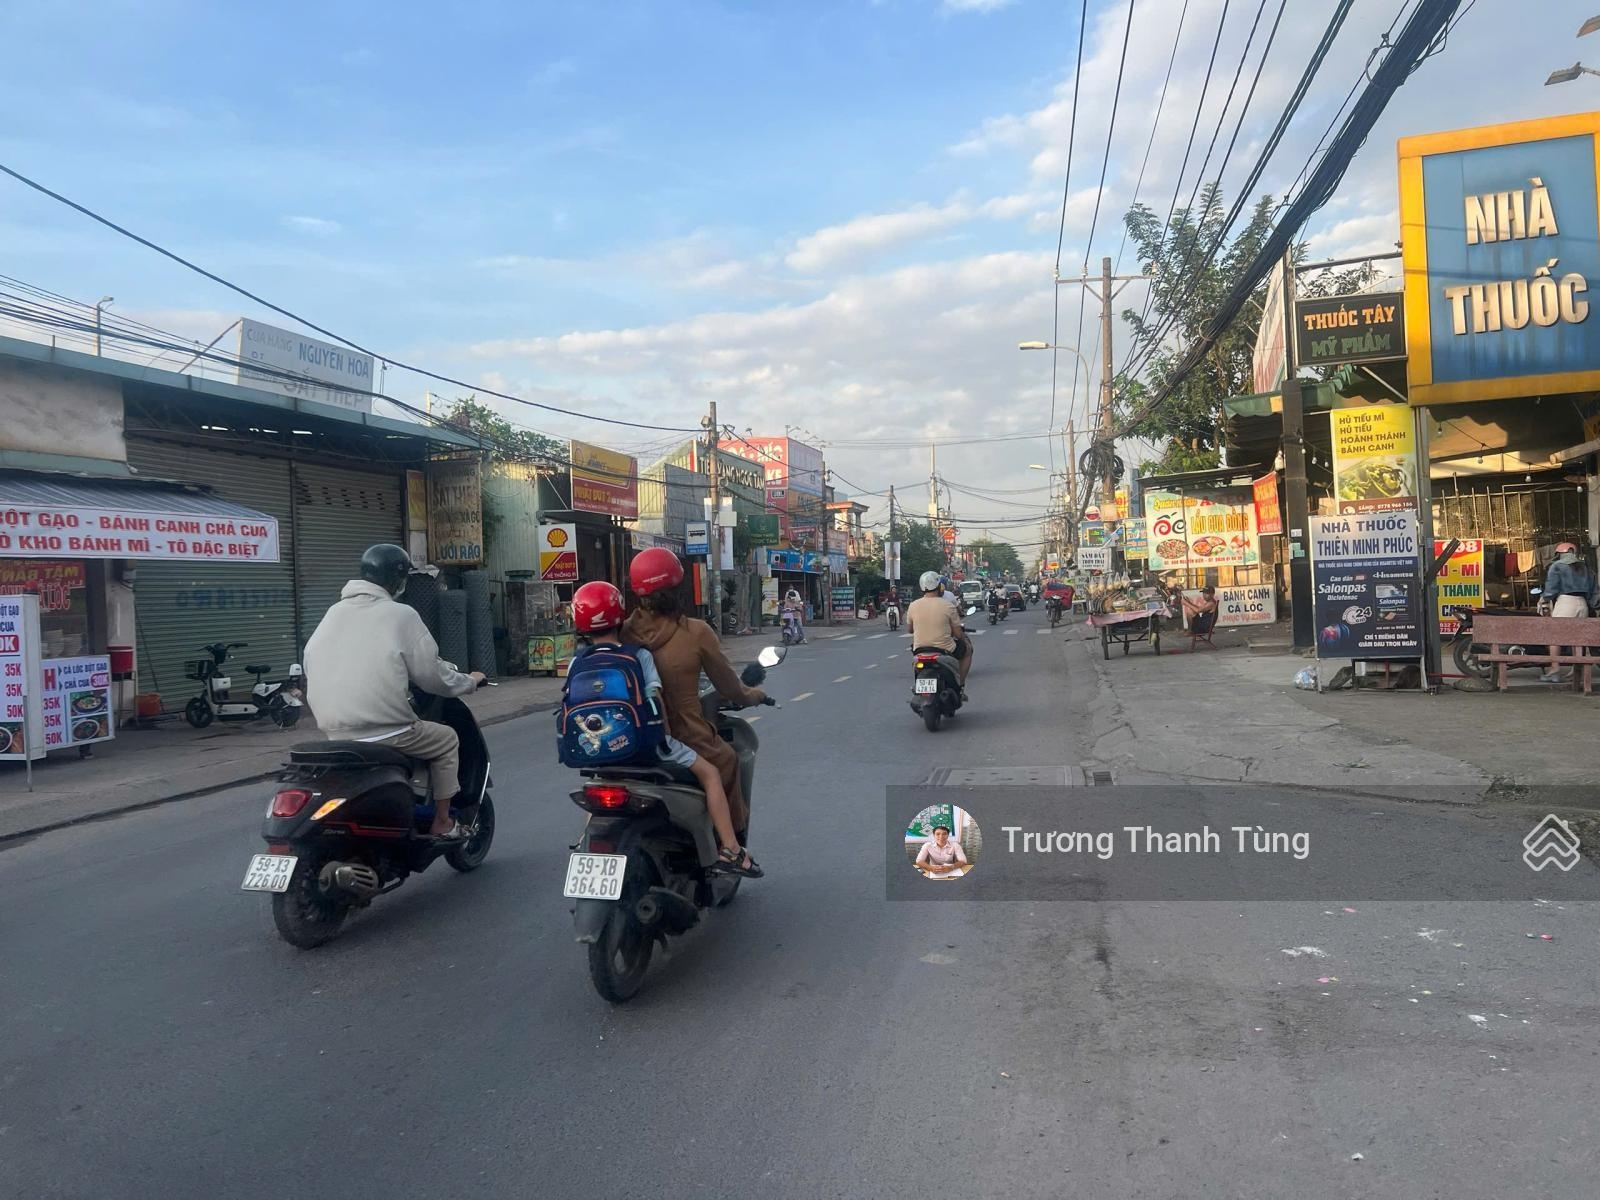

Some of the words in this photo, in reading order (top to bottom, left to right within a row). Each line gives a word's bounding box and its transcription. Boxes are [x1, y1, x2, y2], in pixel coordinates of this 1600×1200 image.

[1465, 177, 1558, 245] NHÀ
[1445, 258, 1589, 335] THUỐC
[1304, 305, 1358, 330] THUỐC
[1362, 305, 1396, 324] TÂY
[1368, 443, 1394, 452] CANH
[0, 509, 30, 528] ỘT
[38, 513, 79, 530] GẠO
[100, 515, 149, 531] BÁNH
[156, 519, 201, 535] CANH
[206, 521, 236, 536] CHẢ
[241, 525, 268, 538] CUA
[1208, 514, 1224, 532] CUA
[1321, 519, 1351, 534] NHÀ
[1356, 515, 1407, 532] THUỐC
[19, 535, 61, 549] KHO
[69, 535, 121, 551] BÁNH
[128, 536, 150, 552] MÌ
[167, 539, 187, 553] TÔ
[193, 540, 223, 557] ĐẶC
[228, 542, 259, 558] BIỆT
[1317, 536, 1349, 556] THIÊN
[1353, 538, 1379, 555] MINH
[1383, 533, 1412, 553] PHÚC
[1223, 588, 1245, 601] BÁNH
[1247, 588, 1270, 600] CANH
[1318, 583, 1367, 594] Salonpas
[1443, 583, 1479, 597] THÁNH
[1228, 602, 1240, 613] CÁ
[1244, 602, 1263, 612] LÓC
[1356, 607, 1371, 618] 24
[5, 664, 21, 677] 35K
[6, 684, 22, 697] 35K
[43, 697, 61, 710] 35K
[7, 705, 24, 717] 50K
[44, 715, 61, 728] 35K
[45, 732, 63, 745] 50K
[256, 858, 290, 873] 59-X3
[577, 857, 617, 876] 59-XB
[570, 876, 617, 896] 364.60
